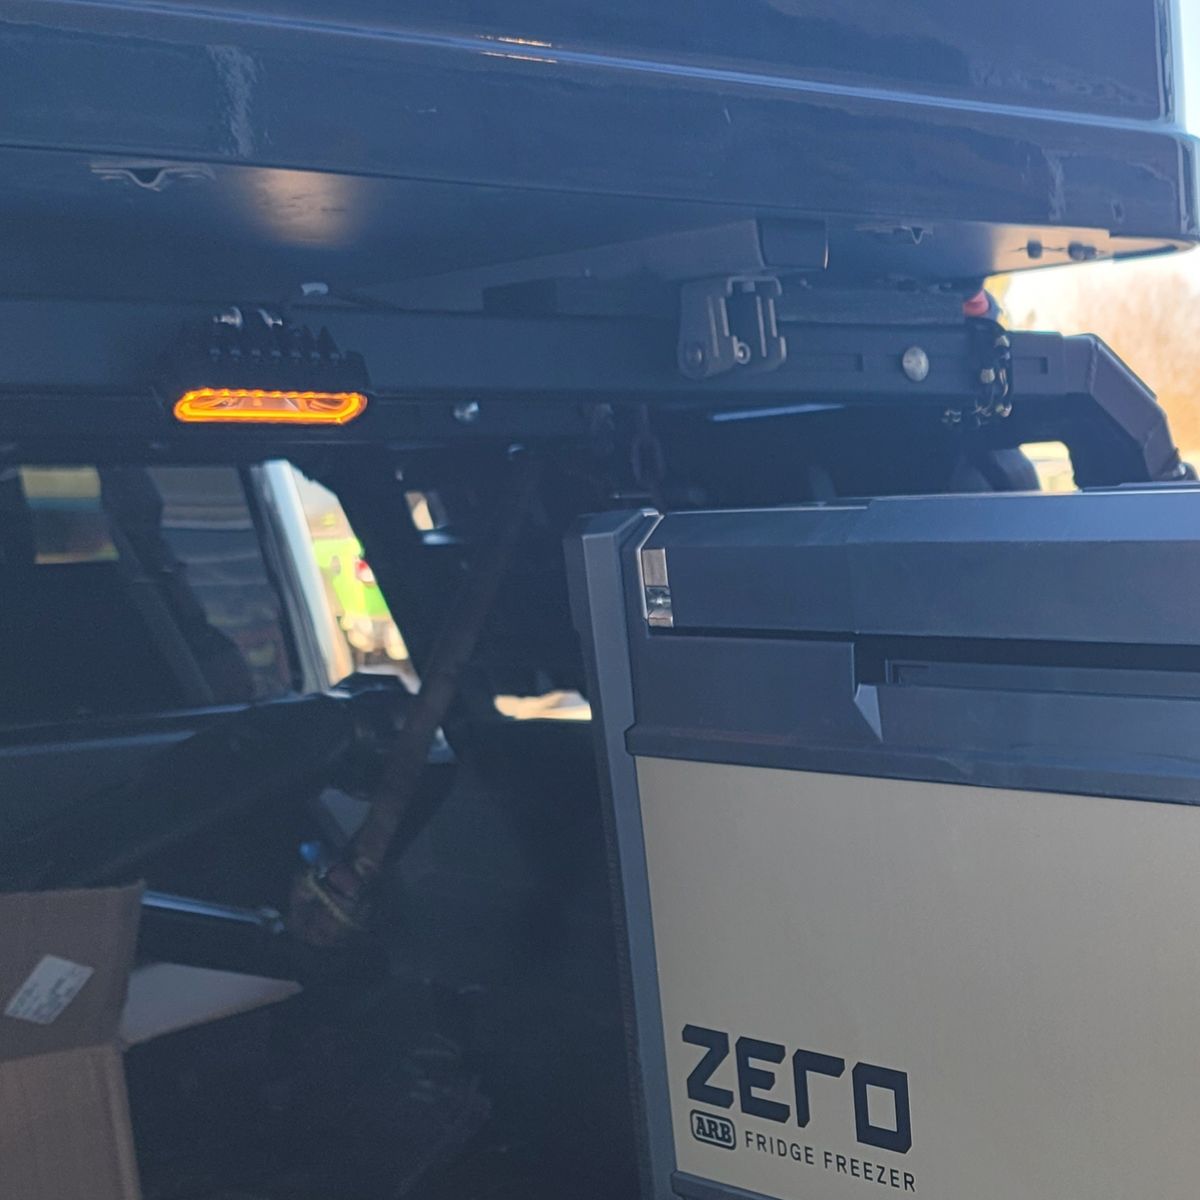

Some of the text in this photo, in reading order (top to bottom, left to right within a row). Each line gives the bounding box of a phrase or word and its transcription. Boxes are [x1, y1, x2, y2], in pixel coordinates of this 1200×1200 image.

[695, 1115, 916, 1193] ARB FRIDGE FREEZER
